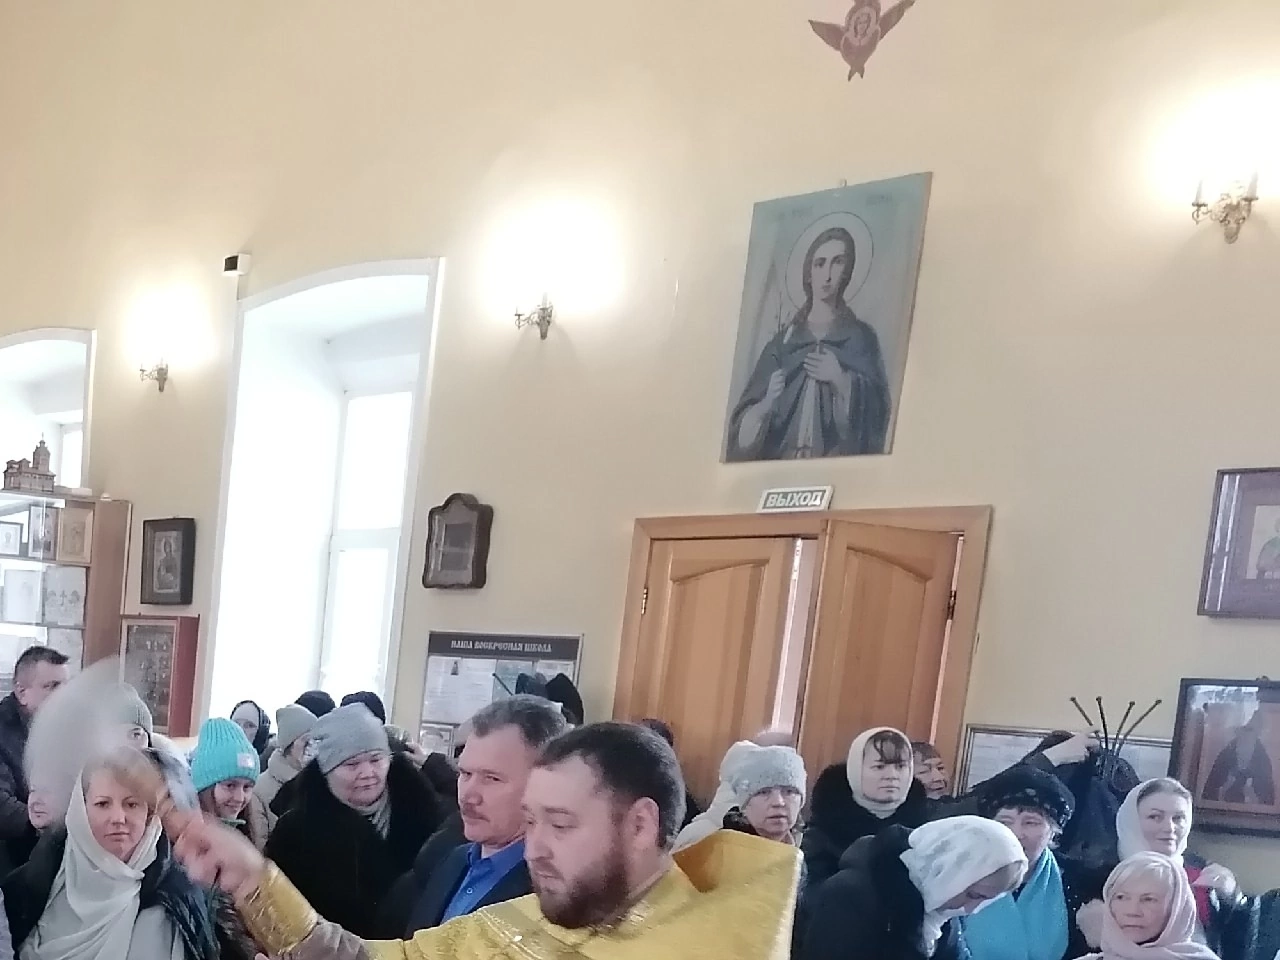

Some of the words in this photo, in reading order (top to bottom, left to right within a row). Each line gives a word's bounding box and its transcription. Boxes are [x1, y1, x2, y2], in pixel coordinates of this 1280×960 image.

[766, 491, 823, 507] ВЫХОД
[451, 640, 473, 649] НАША
[474, 641, 523, 652] ВОСКРЕСНАЯ
[524, 643, 552, 653] ШКОЛА
